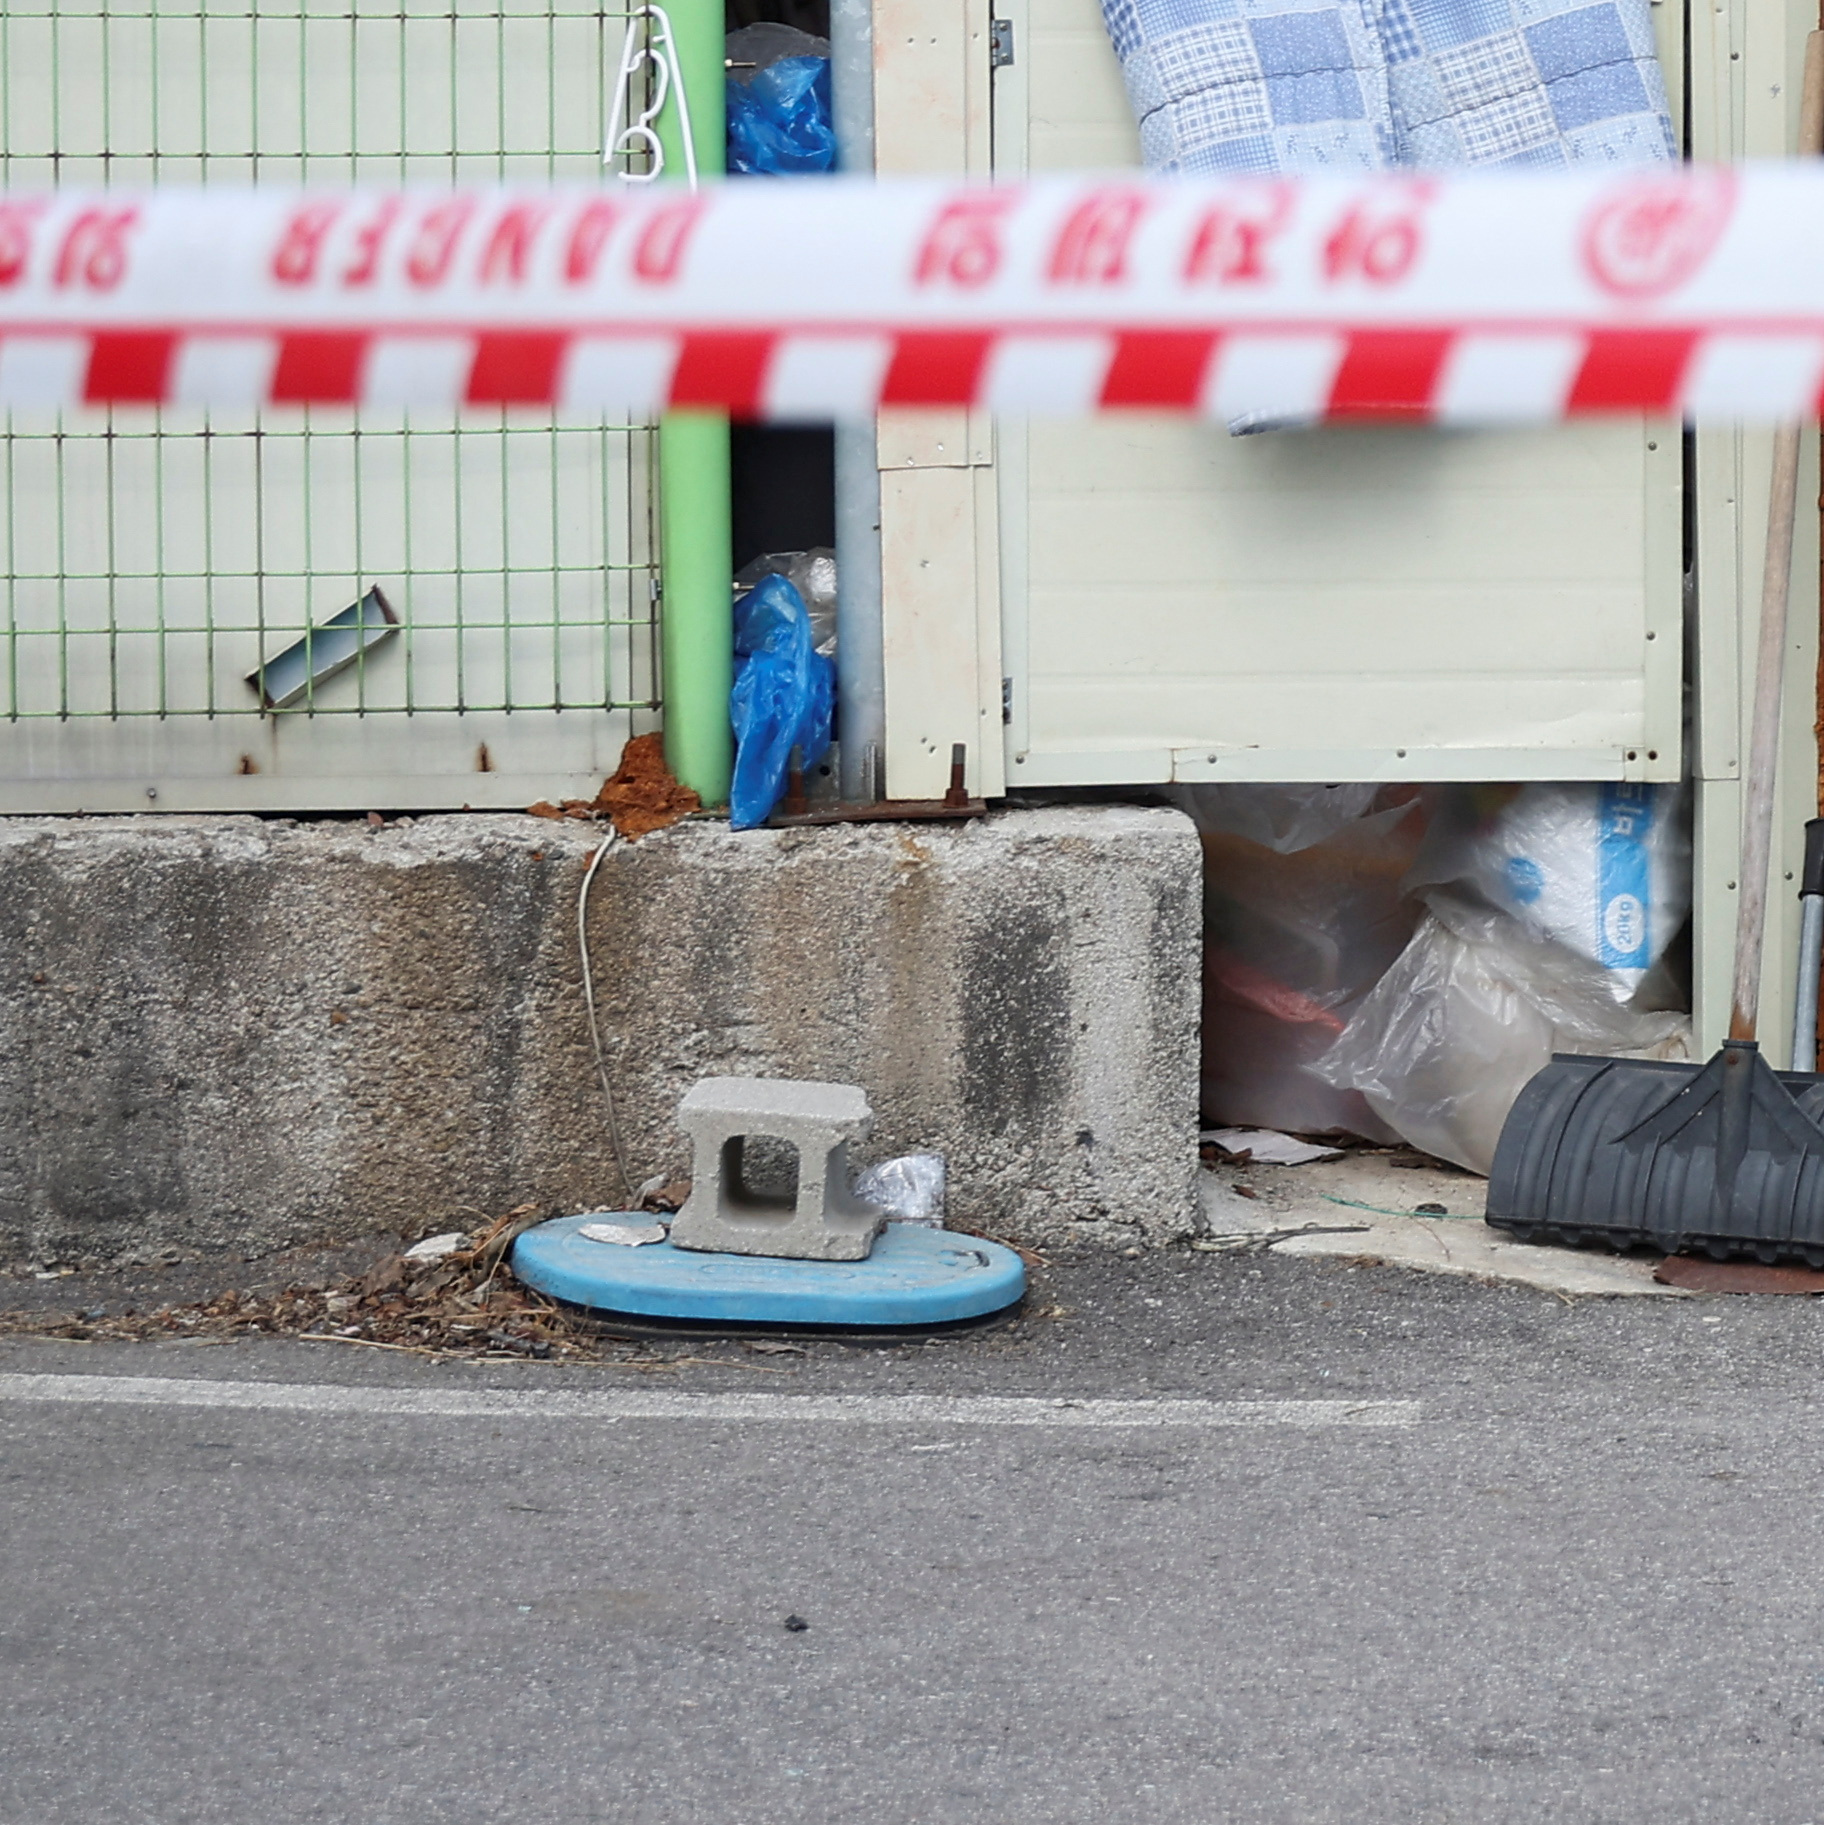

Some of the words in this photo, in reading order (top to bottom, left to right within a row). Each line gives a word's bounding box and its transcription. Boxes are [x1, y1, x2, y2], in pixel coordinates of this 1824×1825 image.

[268, 195, 710, 289] DANGER
[912, 179, 1434, 289] 안전제일
[1615, 900, 1635, 947] 20kg
